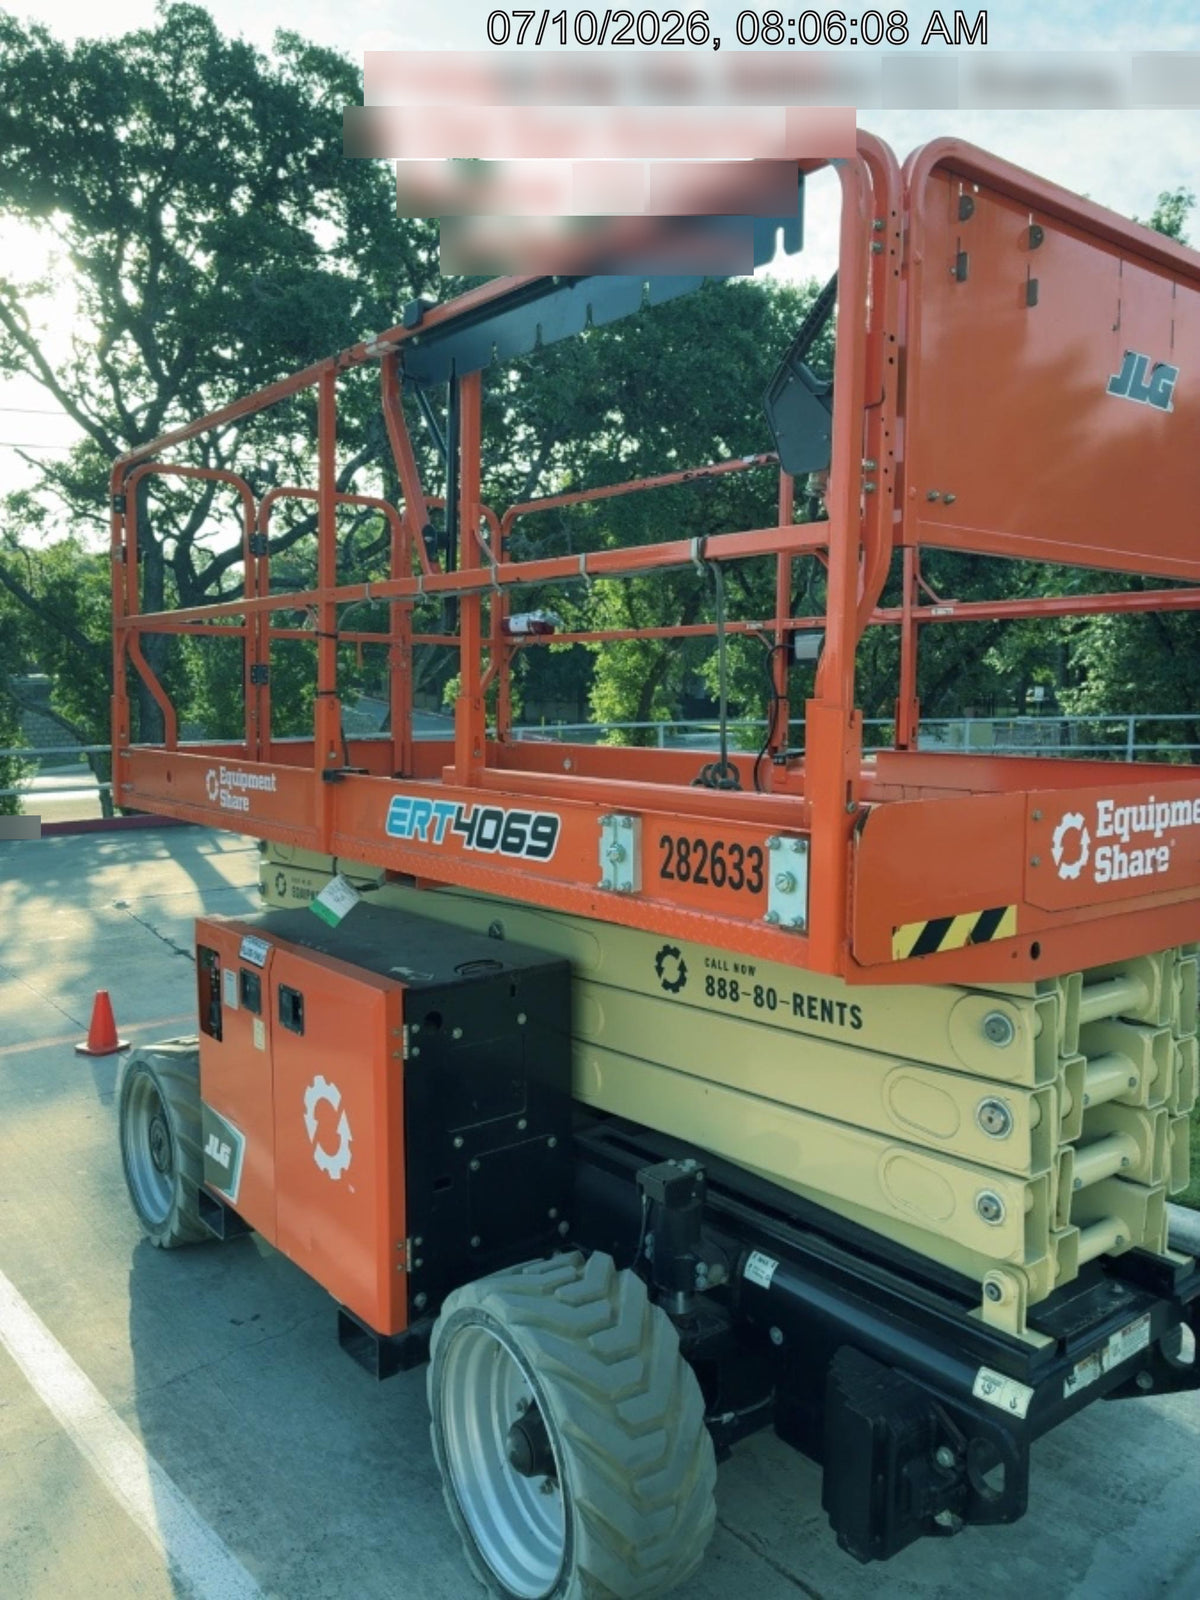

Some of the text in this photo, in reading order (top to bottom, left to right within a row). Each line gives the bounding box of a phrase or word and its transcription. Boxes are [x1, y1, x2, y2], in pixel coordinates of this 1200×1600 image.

[1106, 350, 1179, 413] JLG
[219, 766, 277, 792] Equipment
[220, 789, 249, 811] Share
[386, 795, 561, 862] ERT4069
[659, 835, 763, 893] 282633
[1094, 844, 1169, 883] Share
[704, 957, 756, 977] CALL NOW
[705, 975, 863, 1030] 888-80-RENTS
[205, 1133, 232, 1169] JLG
